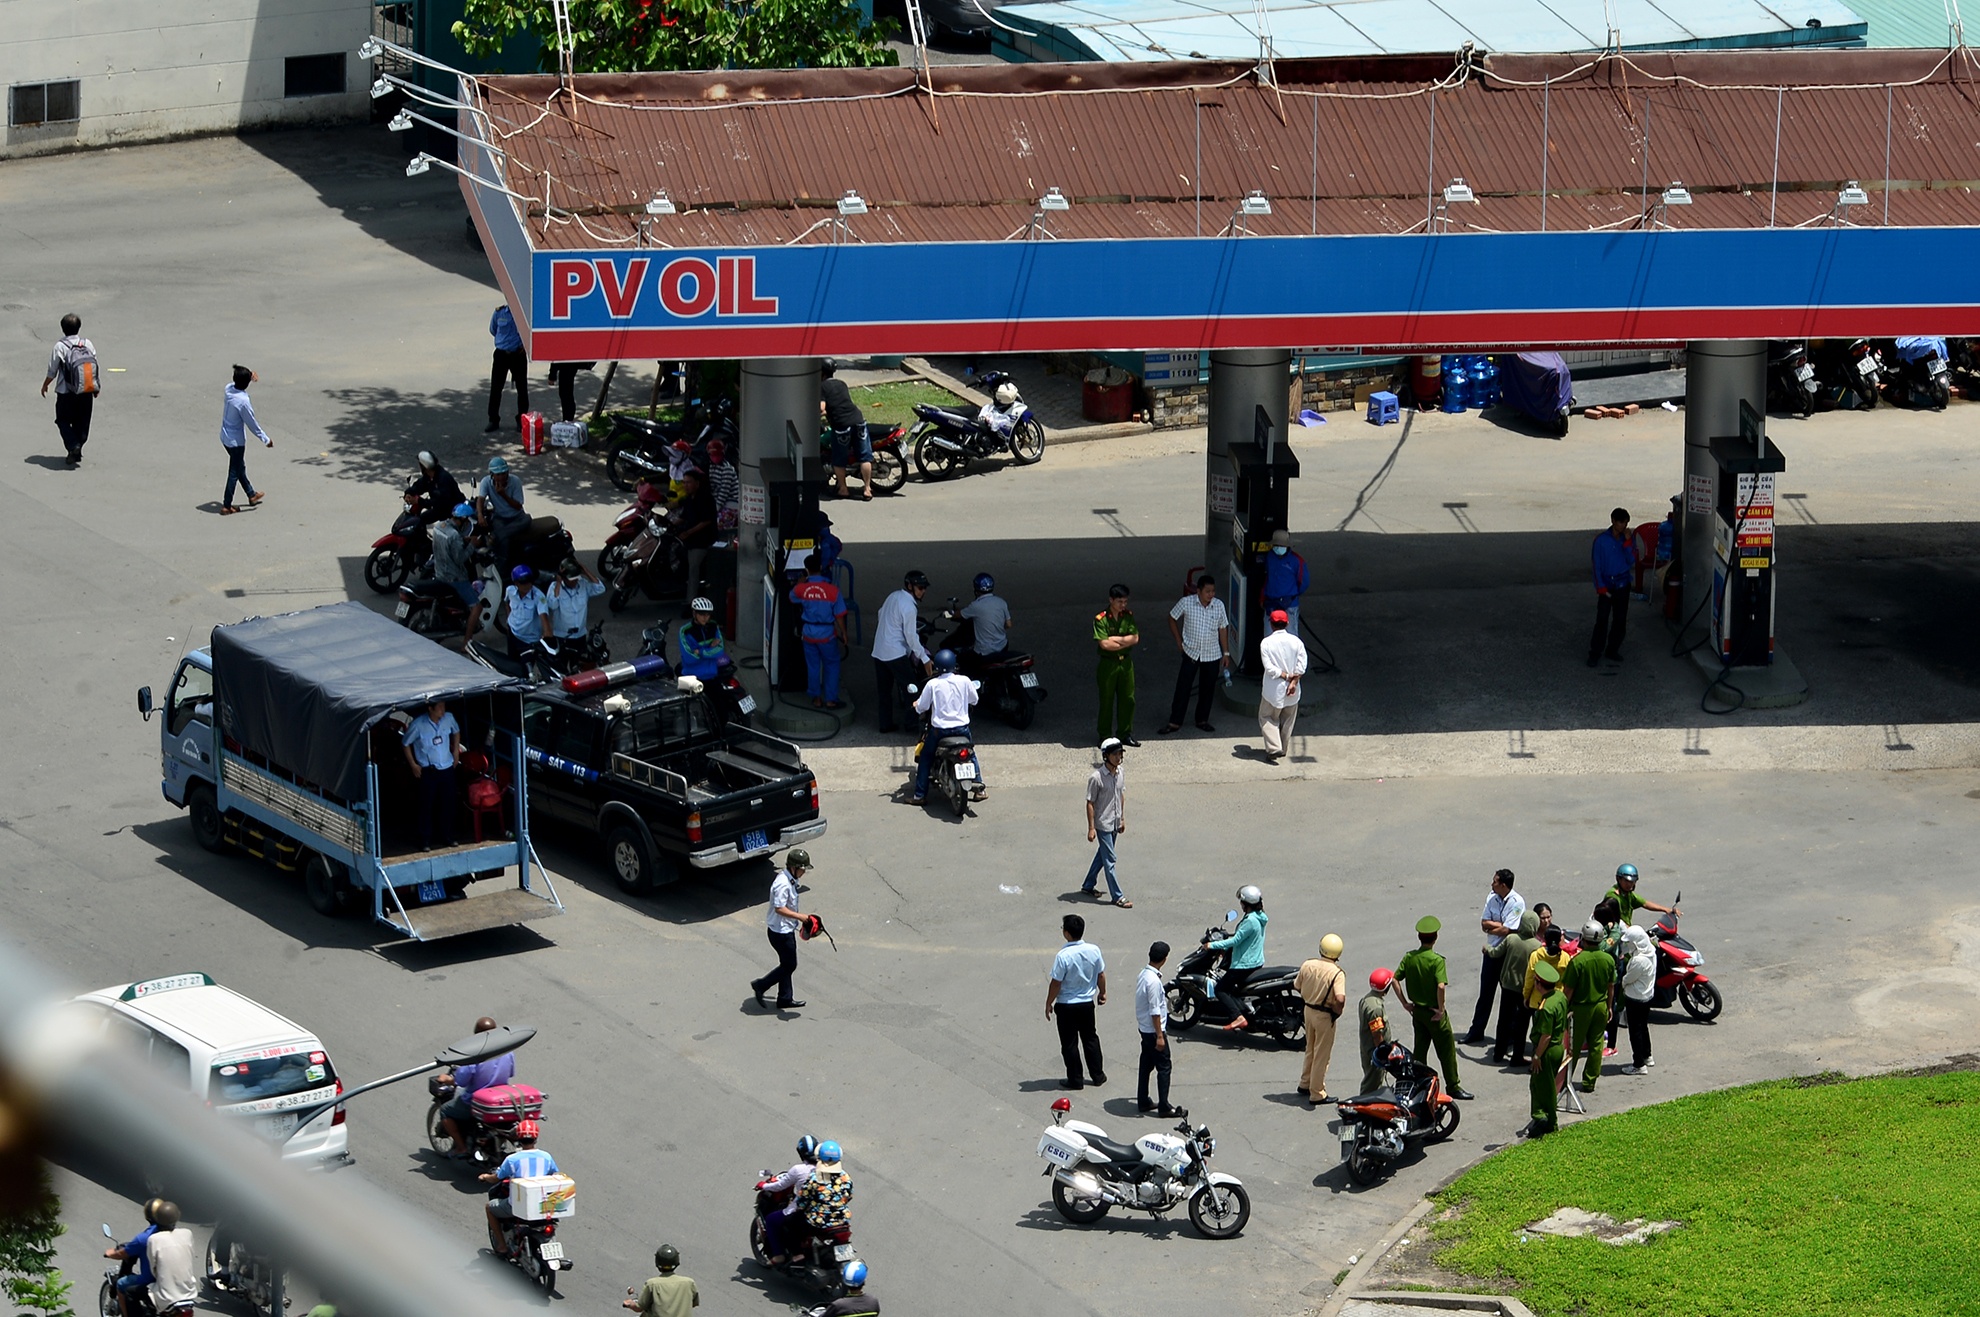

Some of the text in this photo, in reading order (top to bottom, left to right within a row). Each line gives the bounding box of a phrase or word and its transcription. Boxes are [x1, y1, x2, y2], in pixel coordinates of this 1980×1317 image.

[551, 256, 779, 320] PV OIL
[572, 764, 586, 777] 113
[746, 830, 761, 842] 51B
[287, 1094, 311, 1107] 38.27
[313, 1091, 322, 1101] 27
[324, 1088, 334, 1099] 27
[1047, 1145, 1071, 1161] CSGT
[1144, 1140, 1167, 1154] CSGT
